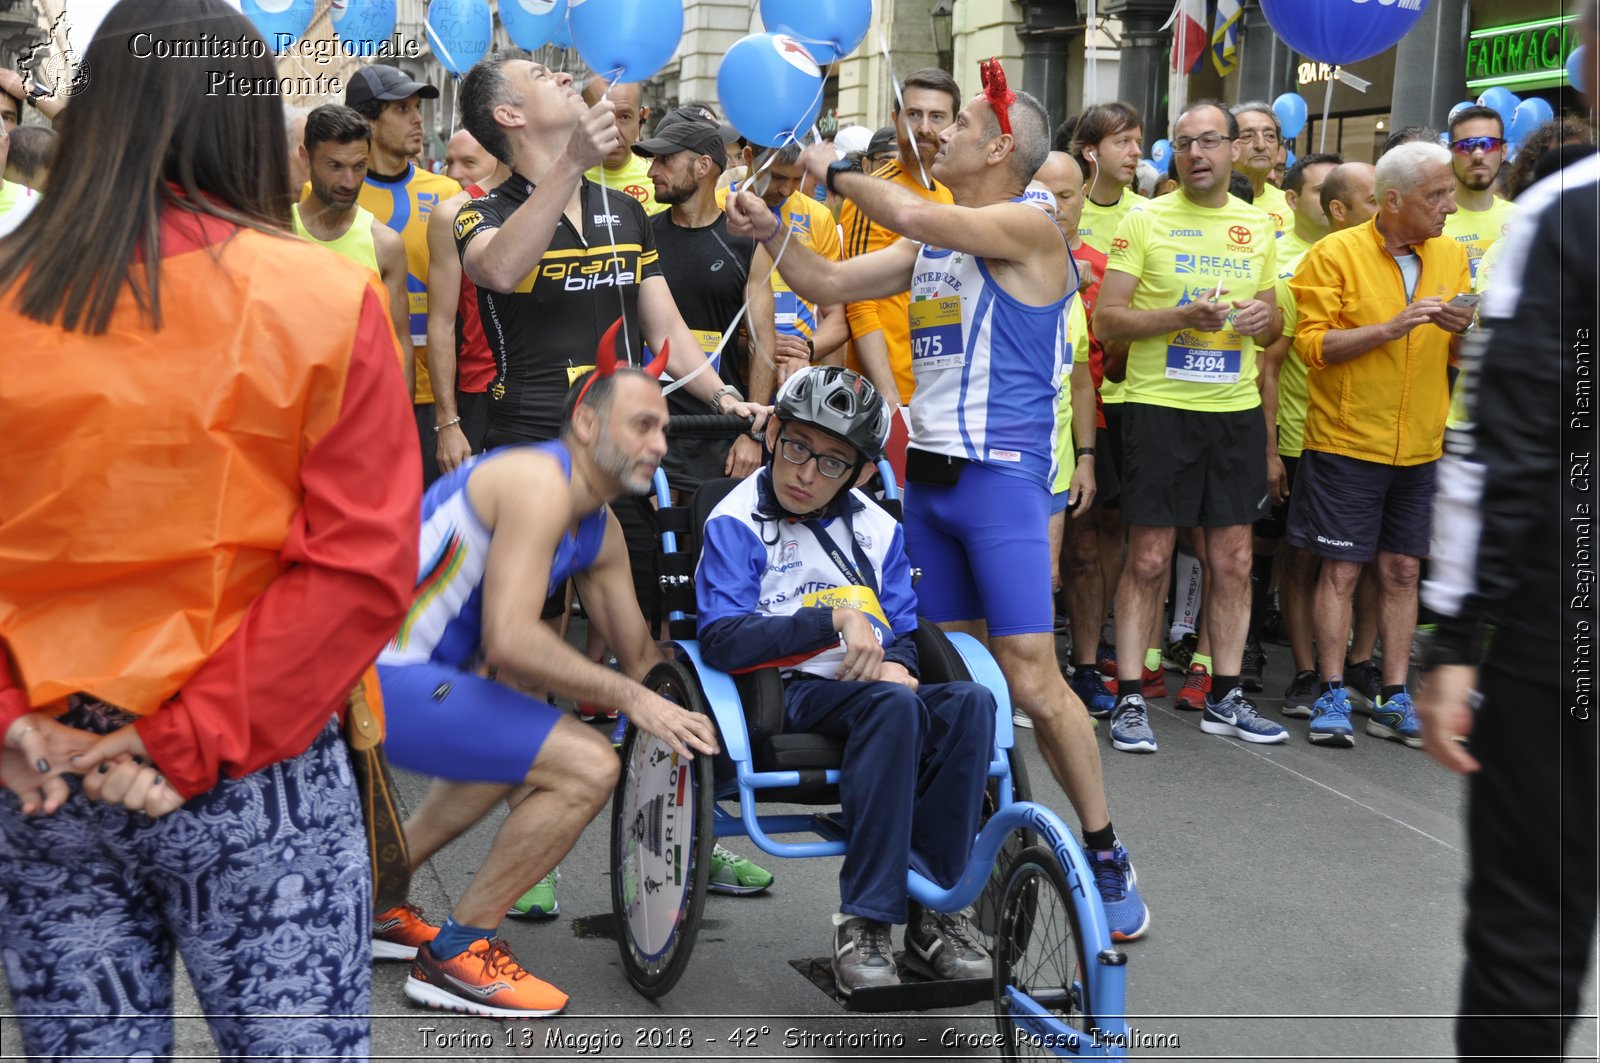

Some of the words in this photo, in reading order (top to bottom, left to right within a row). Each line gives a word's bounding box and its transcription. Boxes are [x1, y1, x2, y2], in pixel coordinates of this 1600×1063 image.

[594, 214, 621, 224] BMC
[1227, 244, 1254, 253] TOYOTA
[542, 257, 626, 280] gran
[1200, 255, 1251, 270] REALE
[564, 272, 635, 291] bike
[1200, 268, 1251, 279] MUTUA
[1184, 354, 1225, 372] 3494
[665, 769, 678, 884] TORINO
